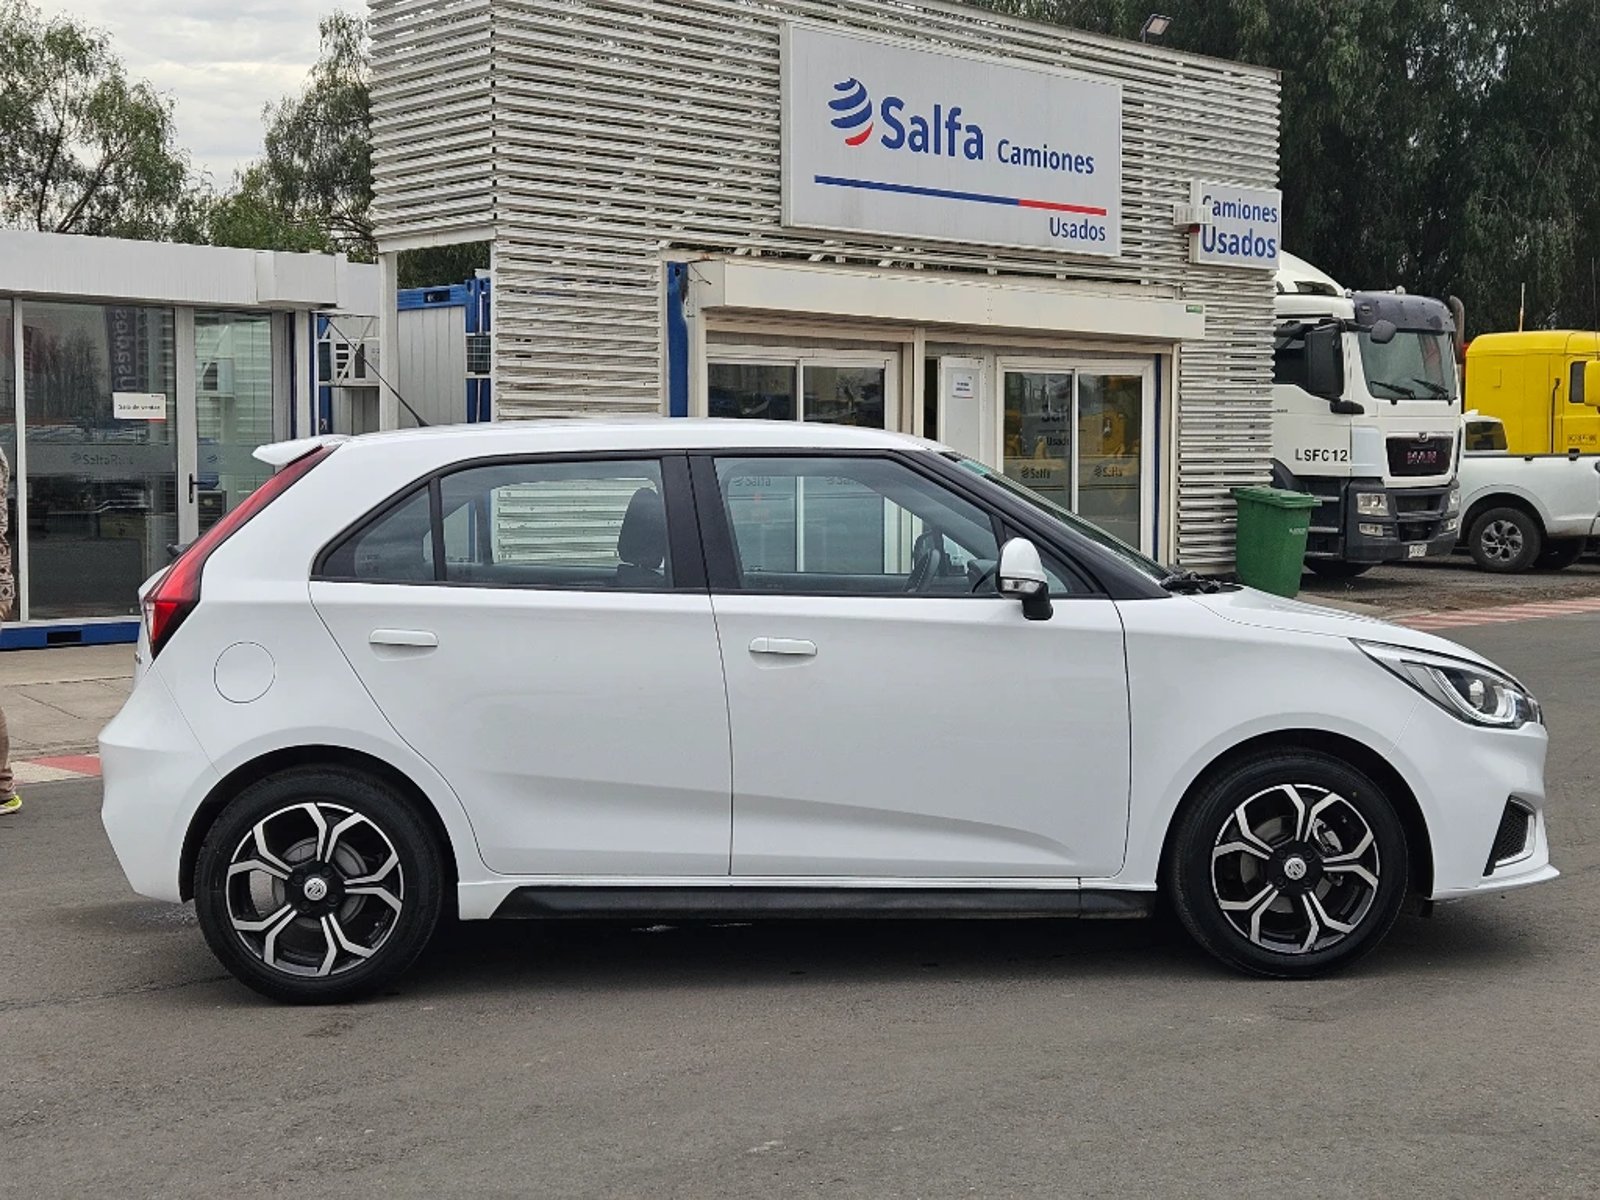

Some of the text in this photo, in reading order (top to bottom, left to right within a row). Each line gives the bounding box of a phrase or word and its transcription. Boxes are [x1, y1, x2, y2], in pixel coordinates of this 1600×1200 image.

[880, 96, 1095, 175] Salfa Camiones
[1049, 216, 1106, 243] Usados
[1202, 224, 1276, 258] Usados
[1295, 449, 1348, 462] LSFC12
